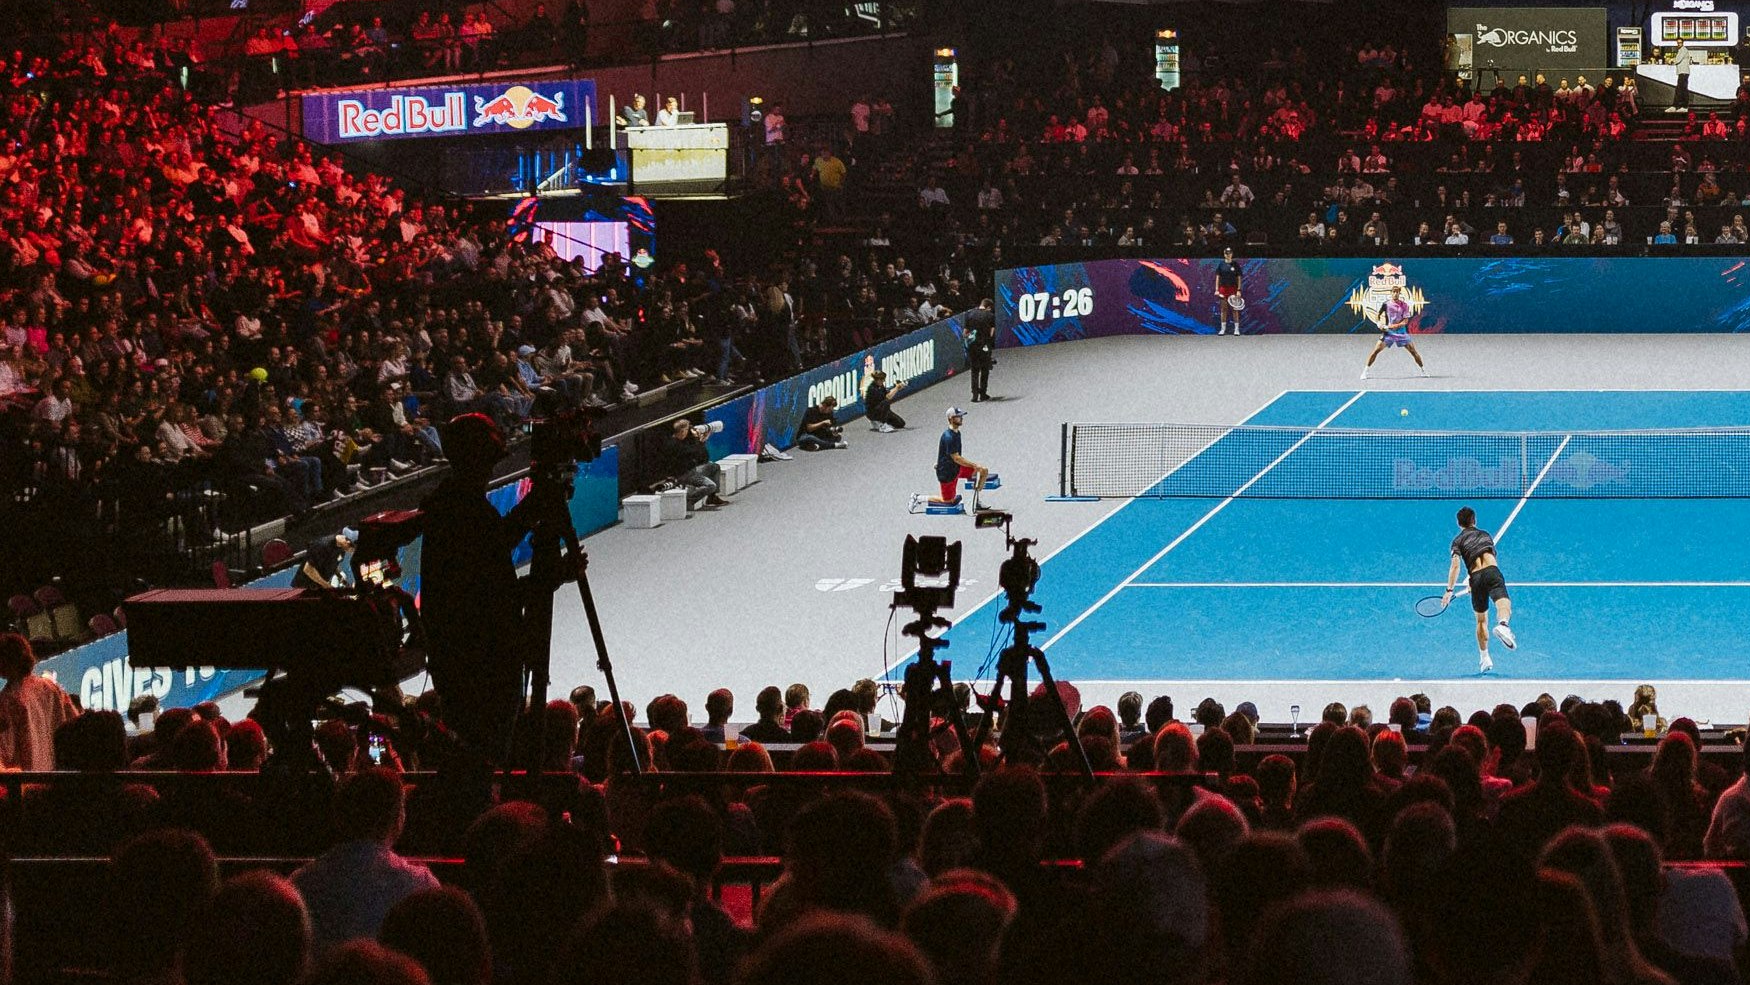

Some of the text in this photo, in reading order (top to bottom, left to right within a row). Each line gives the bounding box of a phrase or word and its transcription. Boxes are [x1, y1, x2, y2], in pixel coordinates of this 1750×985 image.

[1489, 28, 1577, 47] ORGANICS
[341, 94, 465, 135] Red Bull
[1019, 287, 1093, 322] 07:26
[80, 655, 173, 714] GIVES
